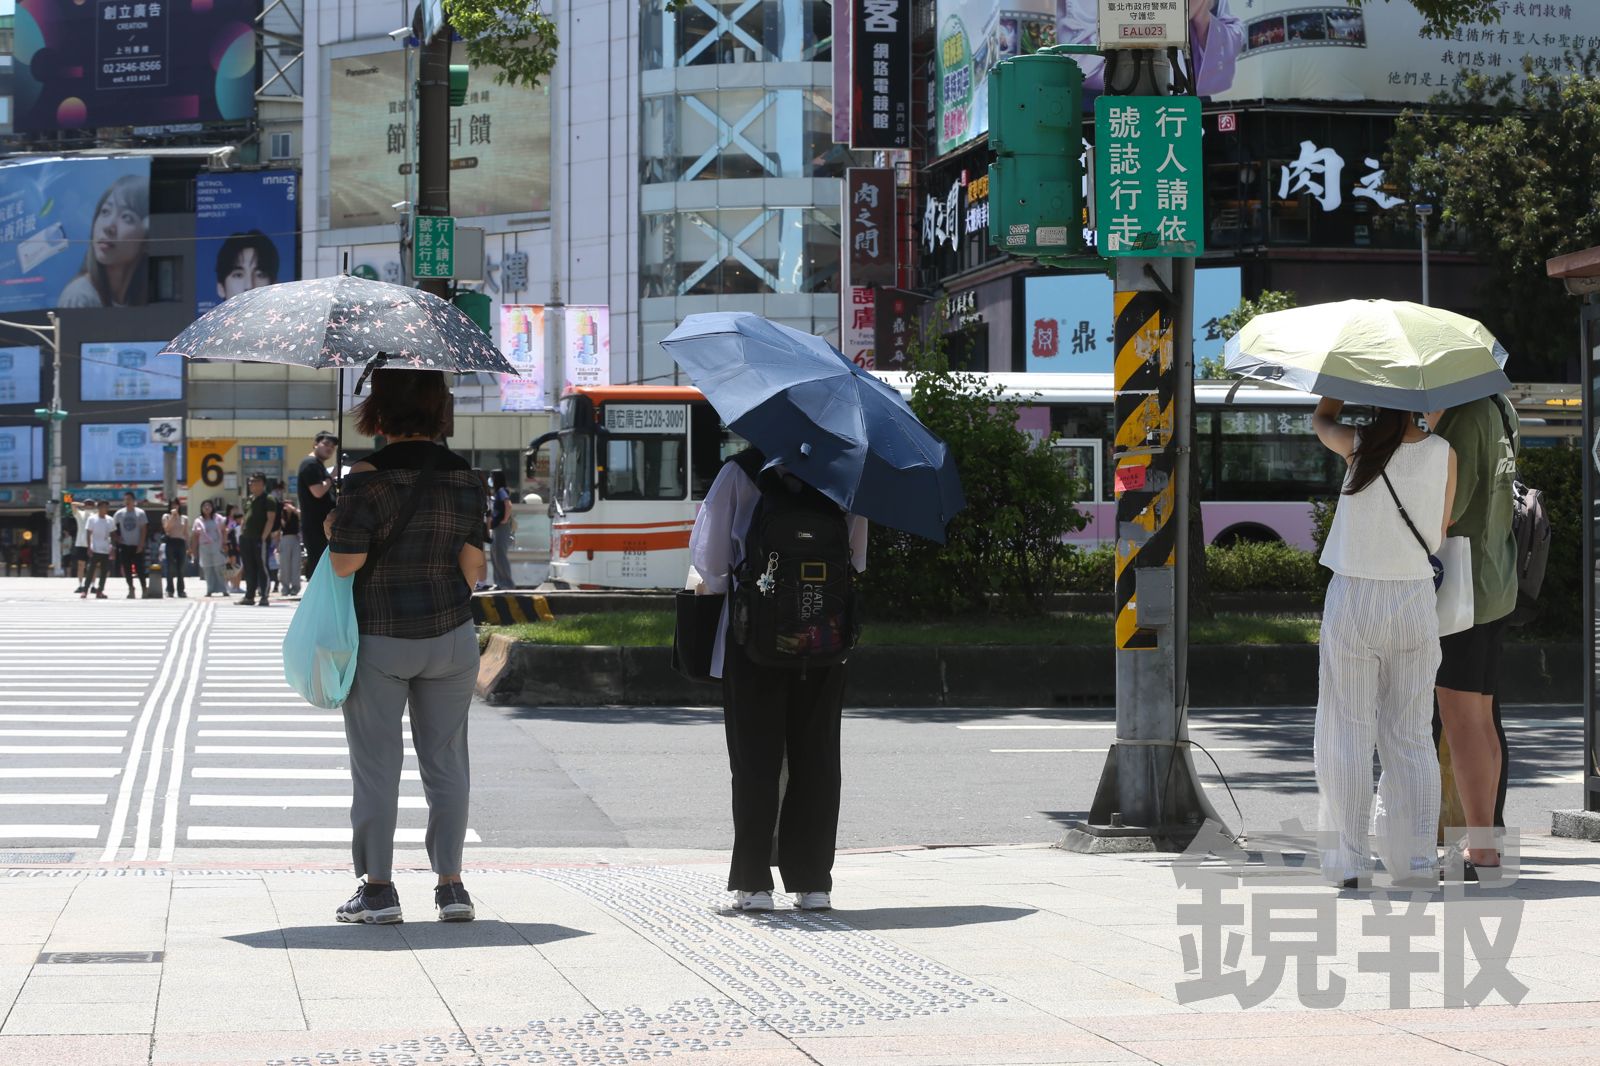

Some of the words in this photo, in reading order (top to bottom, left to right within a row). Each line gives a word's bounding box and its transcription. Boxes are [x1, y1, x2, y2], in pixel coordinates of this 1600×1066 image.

[104, 2, 161, 20] 創立廣告
[1108, 2, 1177, 11] 臺北市政府警察局
[1129, 12, 1156, 20] 守護您
[1123, 26, 1163, 36] EAL023
[103, 63, 114, 74] 02
[115, 60, 162, 73] 2546-8566
[346, 66, 379, 77] Panasonic
[387, 113, 492, 154] 節回饋
[894, 136, 906, 144] 4F
[1108, 106, 1142, 247] 號誌行走
[1155, 105, 1188, 242] 行人請依
[854, 182, 880, 259] 肉之間
[418, 218, 433, 276] 號誌行走
[435, 219, 450, 276] 行人請依
[201, 453, 225, 488] 6
